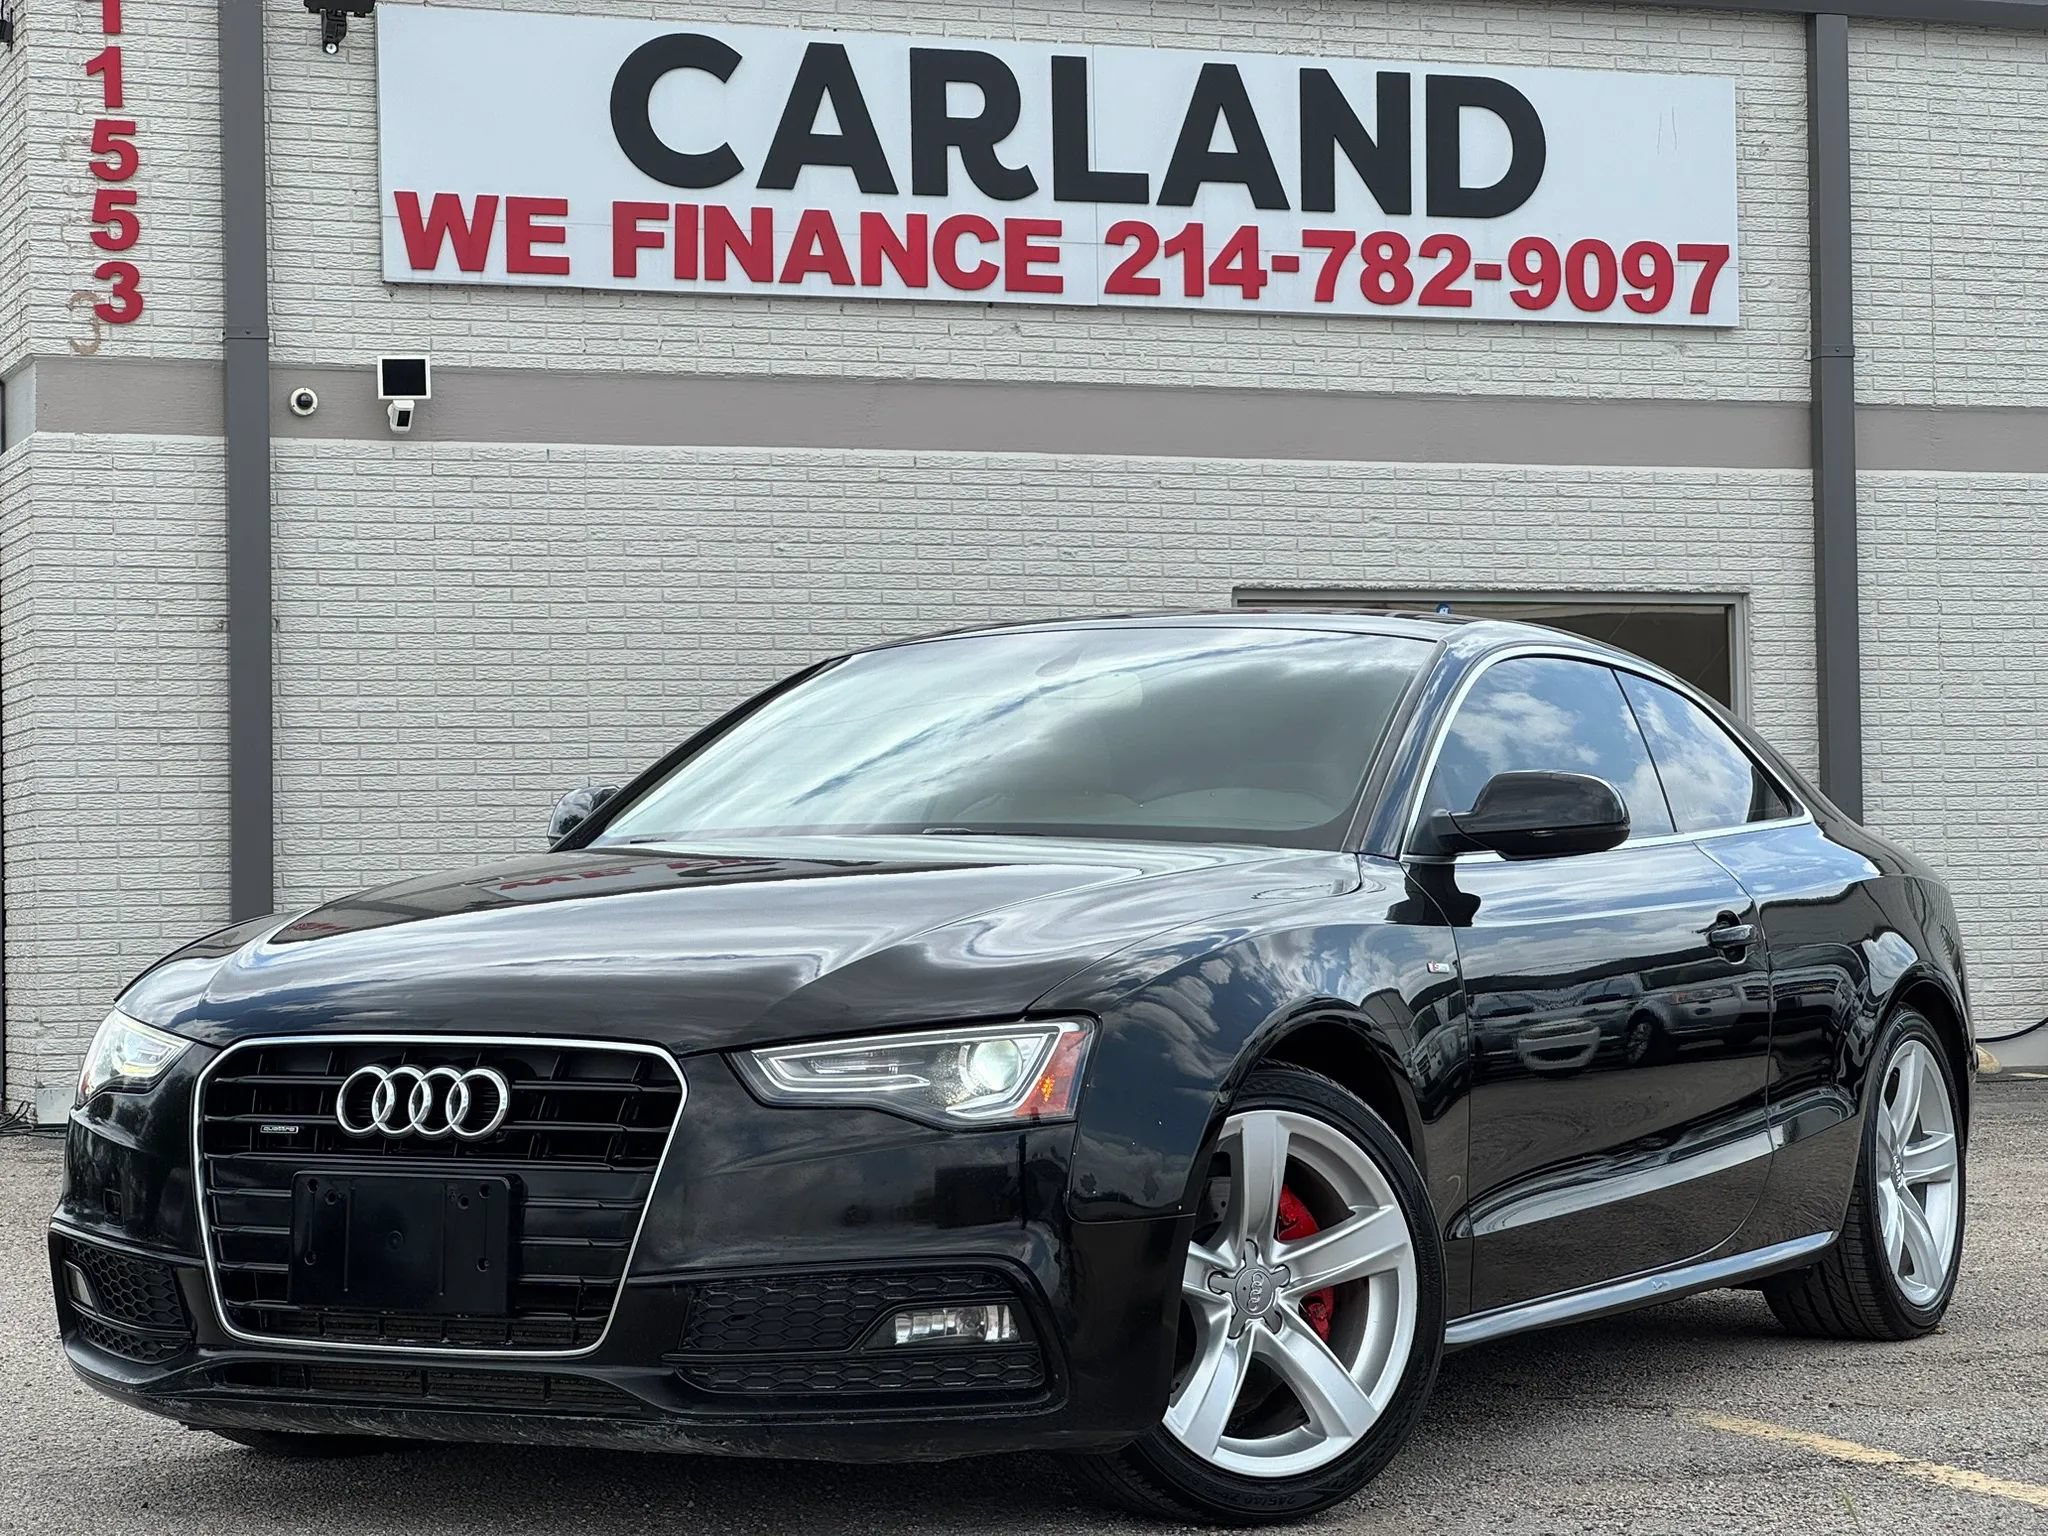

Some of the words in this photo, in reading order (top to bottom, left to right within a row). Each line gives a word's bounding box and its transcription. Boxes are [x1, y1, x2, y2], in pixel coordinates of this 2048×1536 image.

[610, 33, 1547, 218] CARLAND
[394, 191, 569, 275] WE
[612, 201, 1064, 293] FINANCE
[1105, 221, 1728, 313] 214-782-9097
